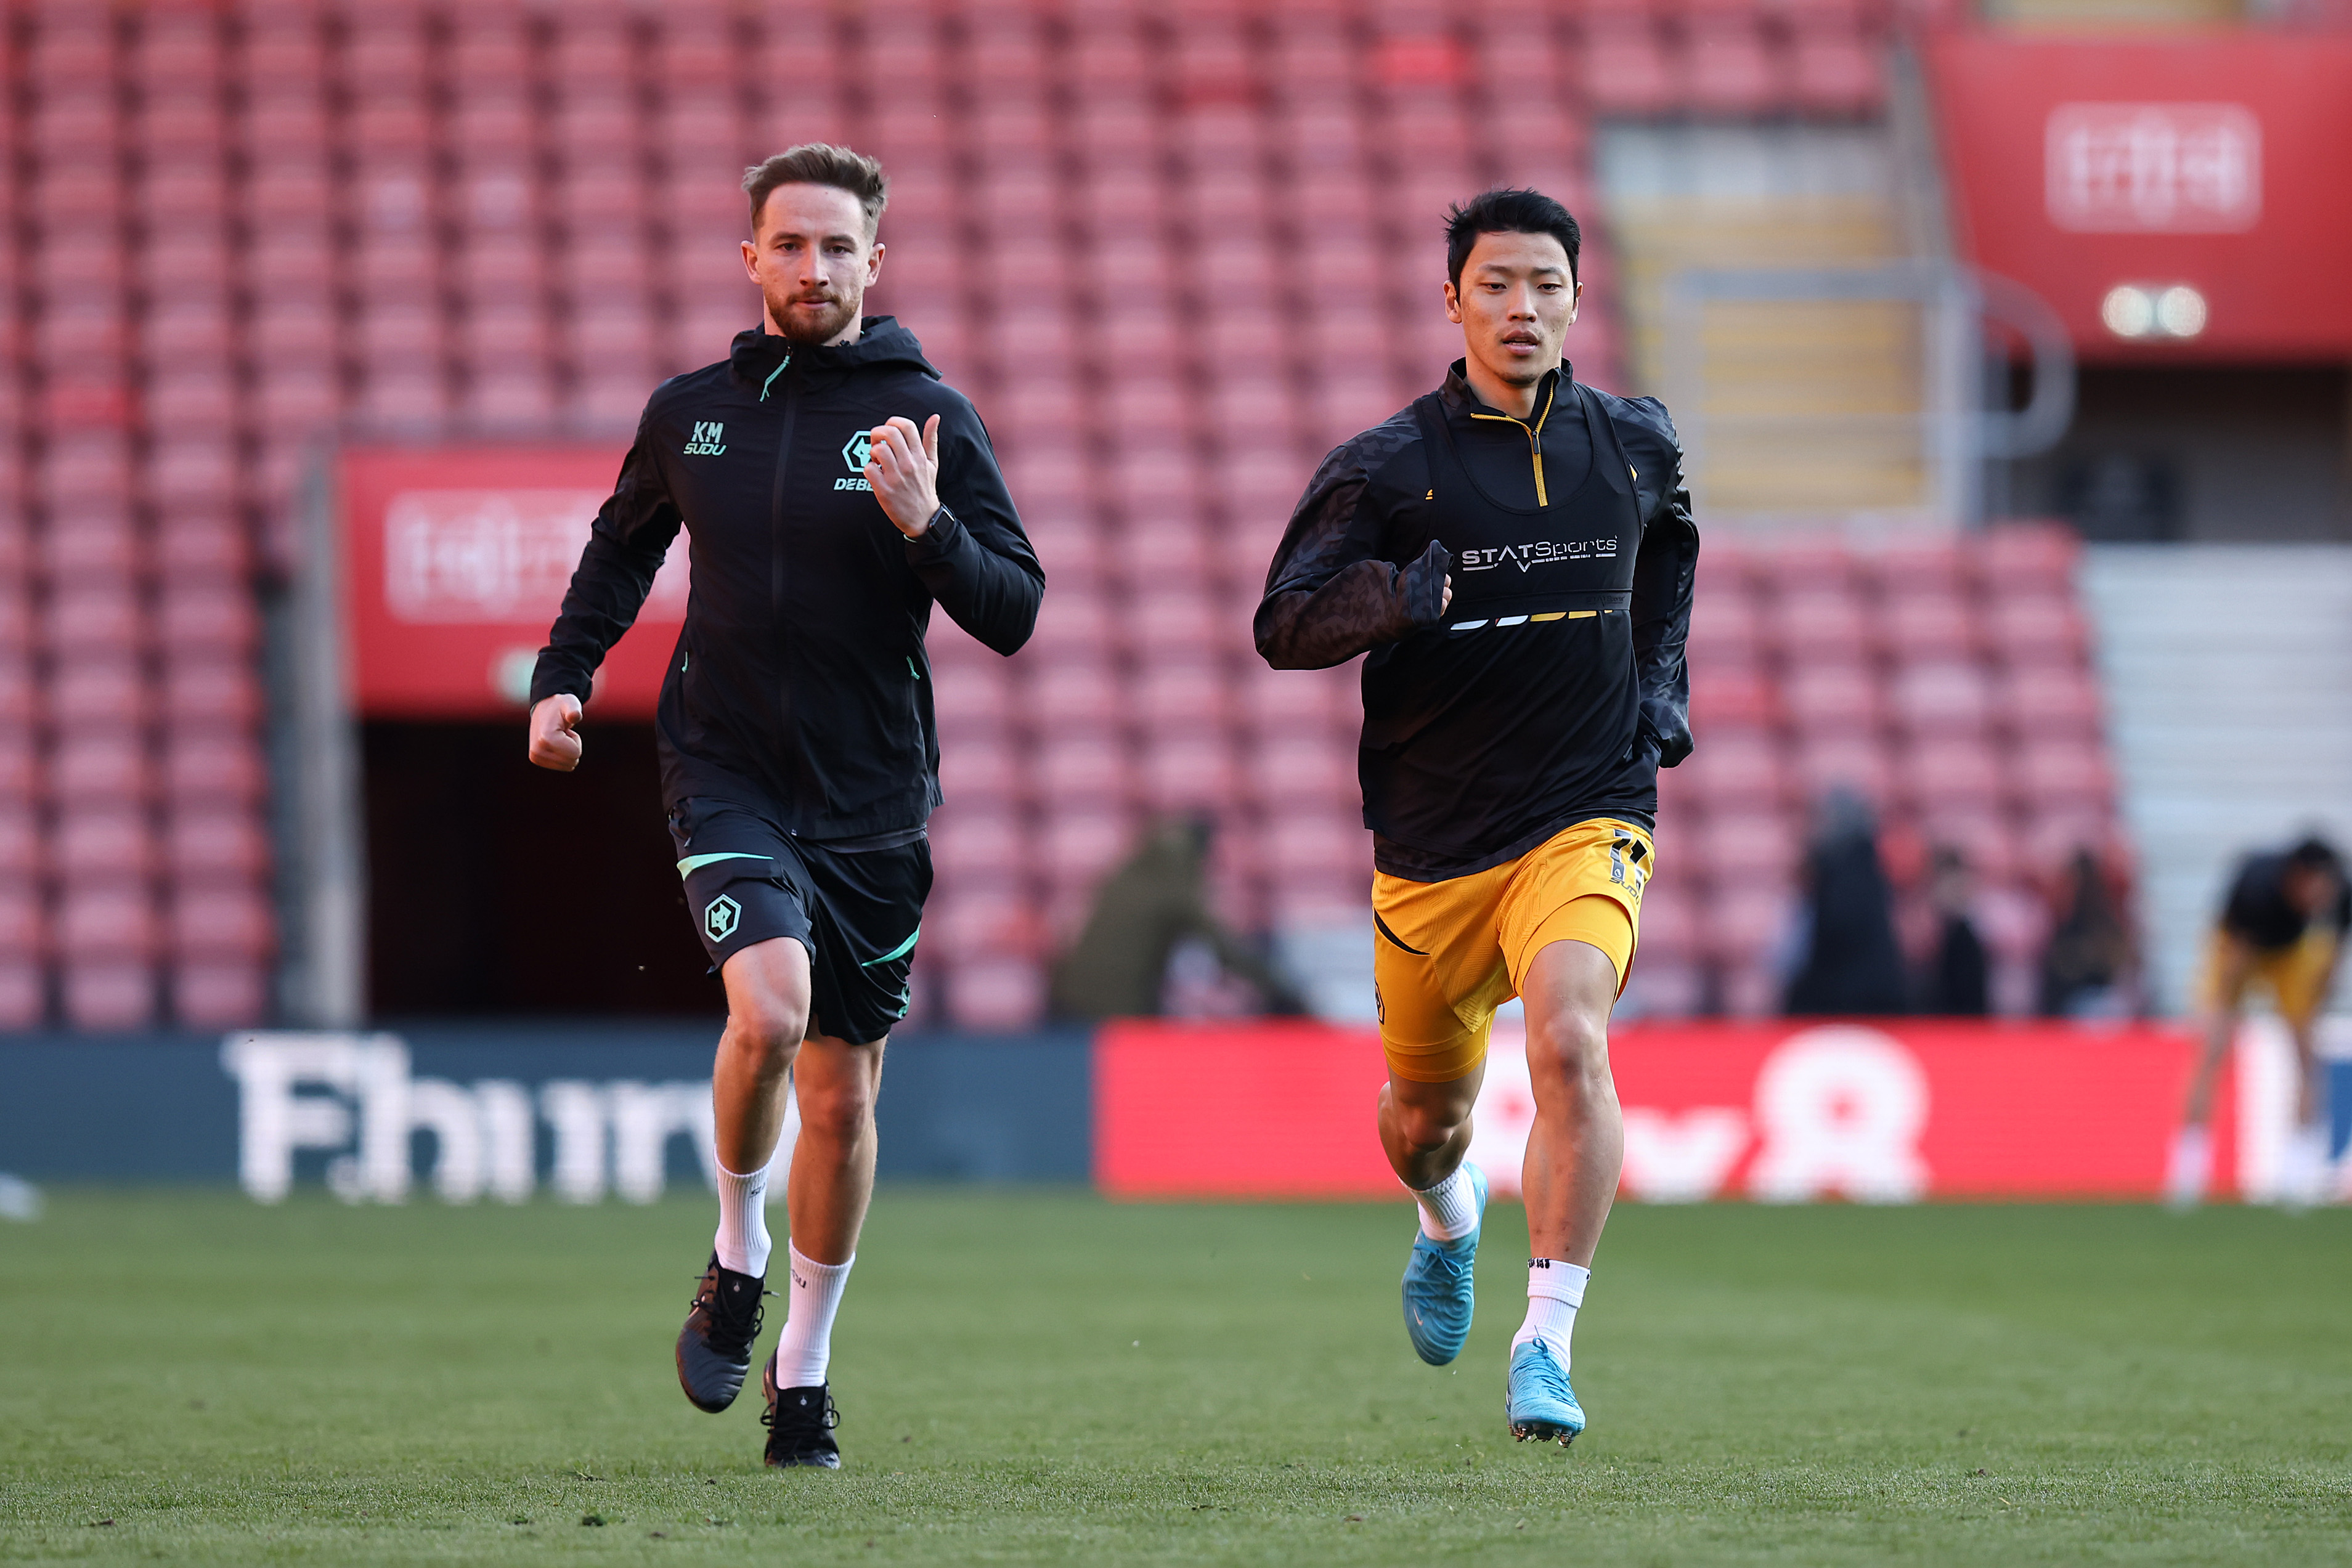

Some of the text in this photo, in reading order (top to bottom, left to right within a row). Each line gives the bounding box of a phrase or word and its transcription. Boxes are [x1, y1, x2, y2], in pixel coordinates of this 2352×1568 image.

[691, 421, 723, 443] KM
[683, 442, 727, 456] SUDU
[1462, 535, 1618, 568] STATSports
